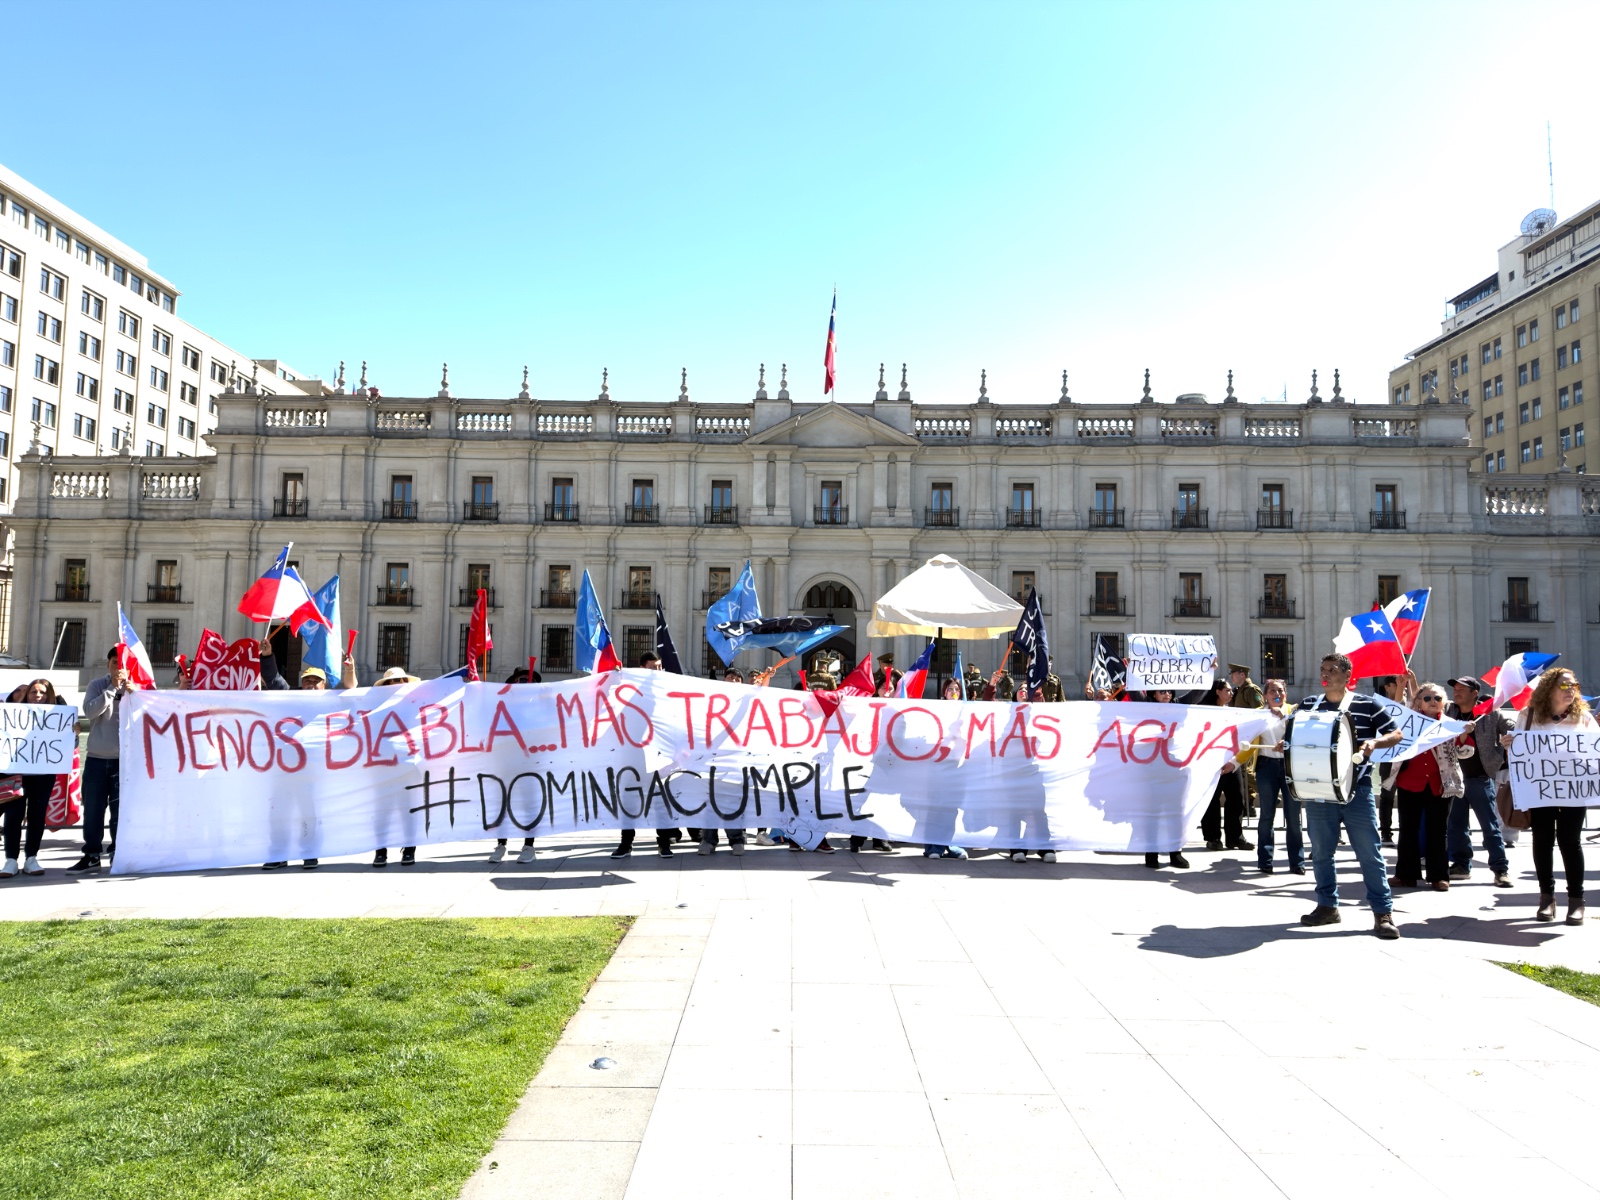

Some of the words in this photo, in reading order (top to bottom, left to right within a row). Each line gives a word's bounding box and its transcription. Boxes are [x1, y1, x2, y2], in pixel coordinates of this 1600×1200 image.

[1150, 656, 1194, 674] DEBER
[143, 708, 308, 780] MENOS
[556, 674, 655, 750] MÁS
[965, 704, 1062, 760] MÁS
[405, 762, 875, 839] #DOMINGACUMPLE
